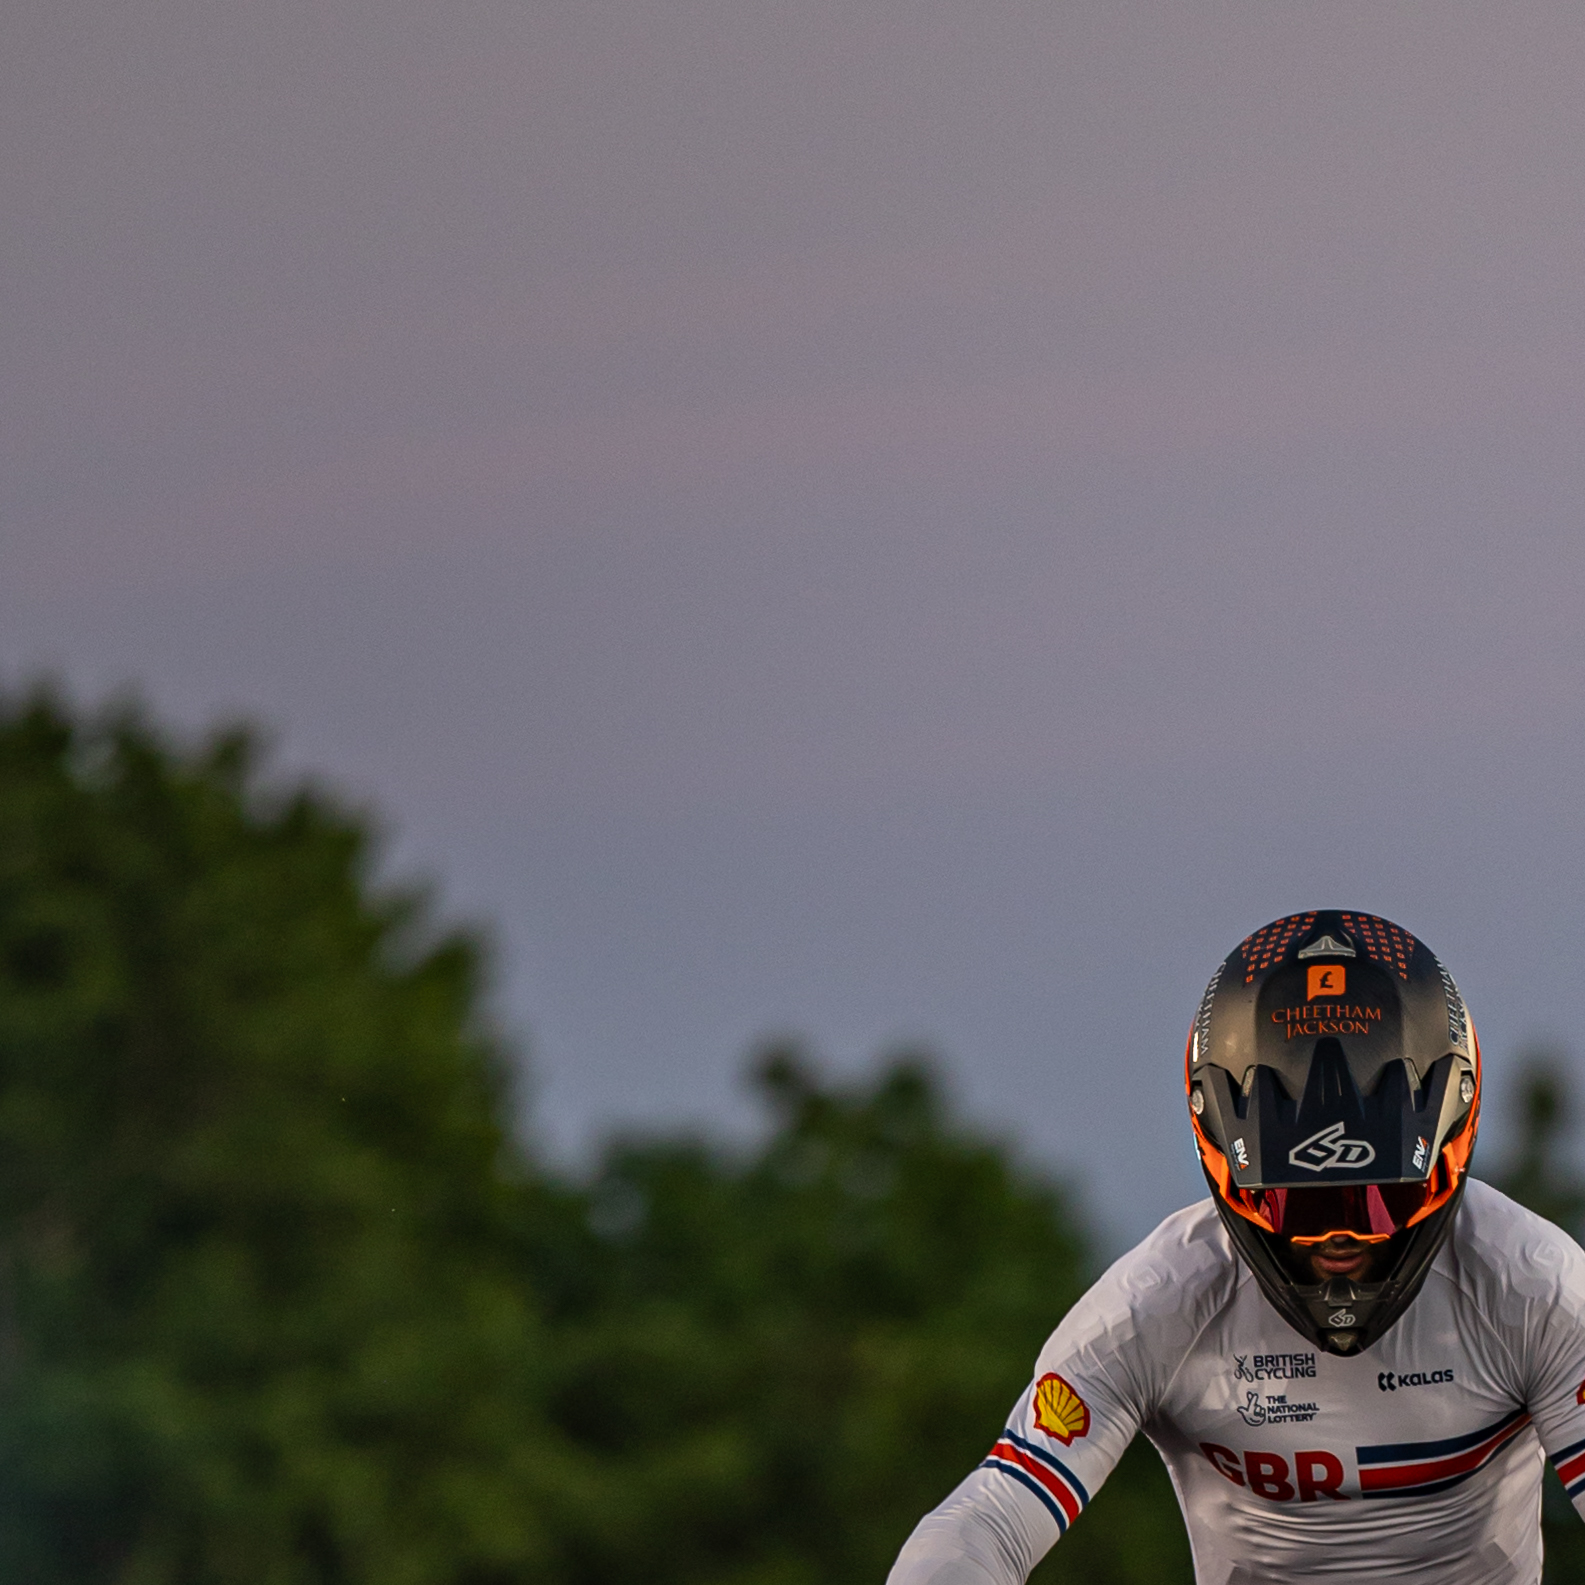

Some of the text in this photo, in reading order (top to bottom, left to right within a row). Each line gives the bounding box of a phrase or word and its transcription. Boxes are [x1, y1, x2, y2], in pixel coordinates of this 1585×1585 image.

[1271, 1004, 1382, 1023] CHEETHAM
[1286, 1020, 1369, 1040] JACKSON
[1252, 1352, 1315, 1368] BRITISH
[1254, 1366, 1317, 1380] CYCLING
[1265, 1394, 1287, 1405] THE
[1267, 1402, 1320, 1414] NATIONAL
[1267, 1412, 1318, 1424] LOTTERY
[1199, 1442, 1352, 1502] GBR
